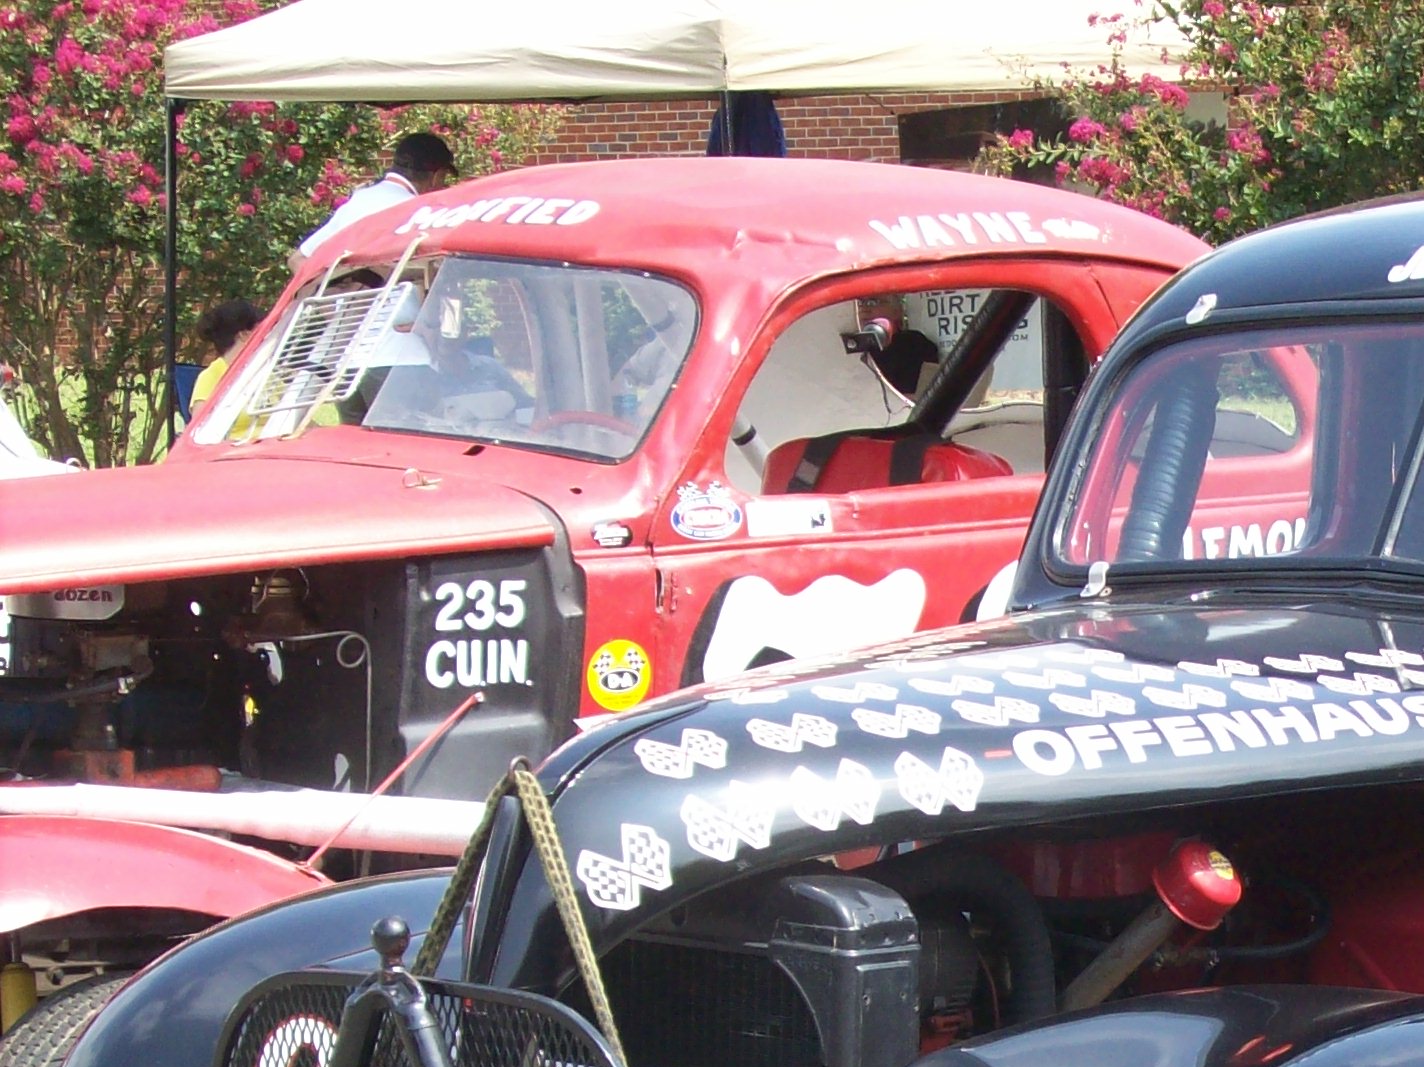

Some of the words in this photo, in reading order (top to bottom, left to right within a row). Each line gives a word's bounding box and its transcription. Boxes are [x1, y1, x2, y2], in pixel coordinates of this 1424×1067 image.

[869, 211, 1047, 249] WAYNE
[927, 294, 980, 317] DIRT
[435, 579, 527, 631] 235
